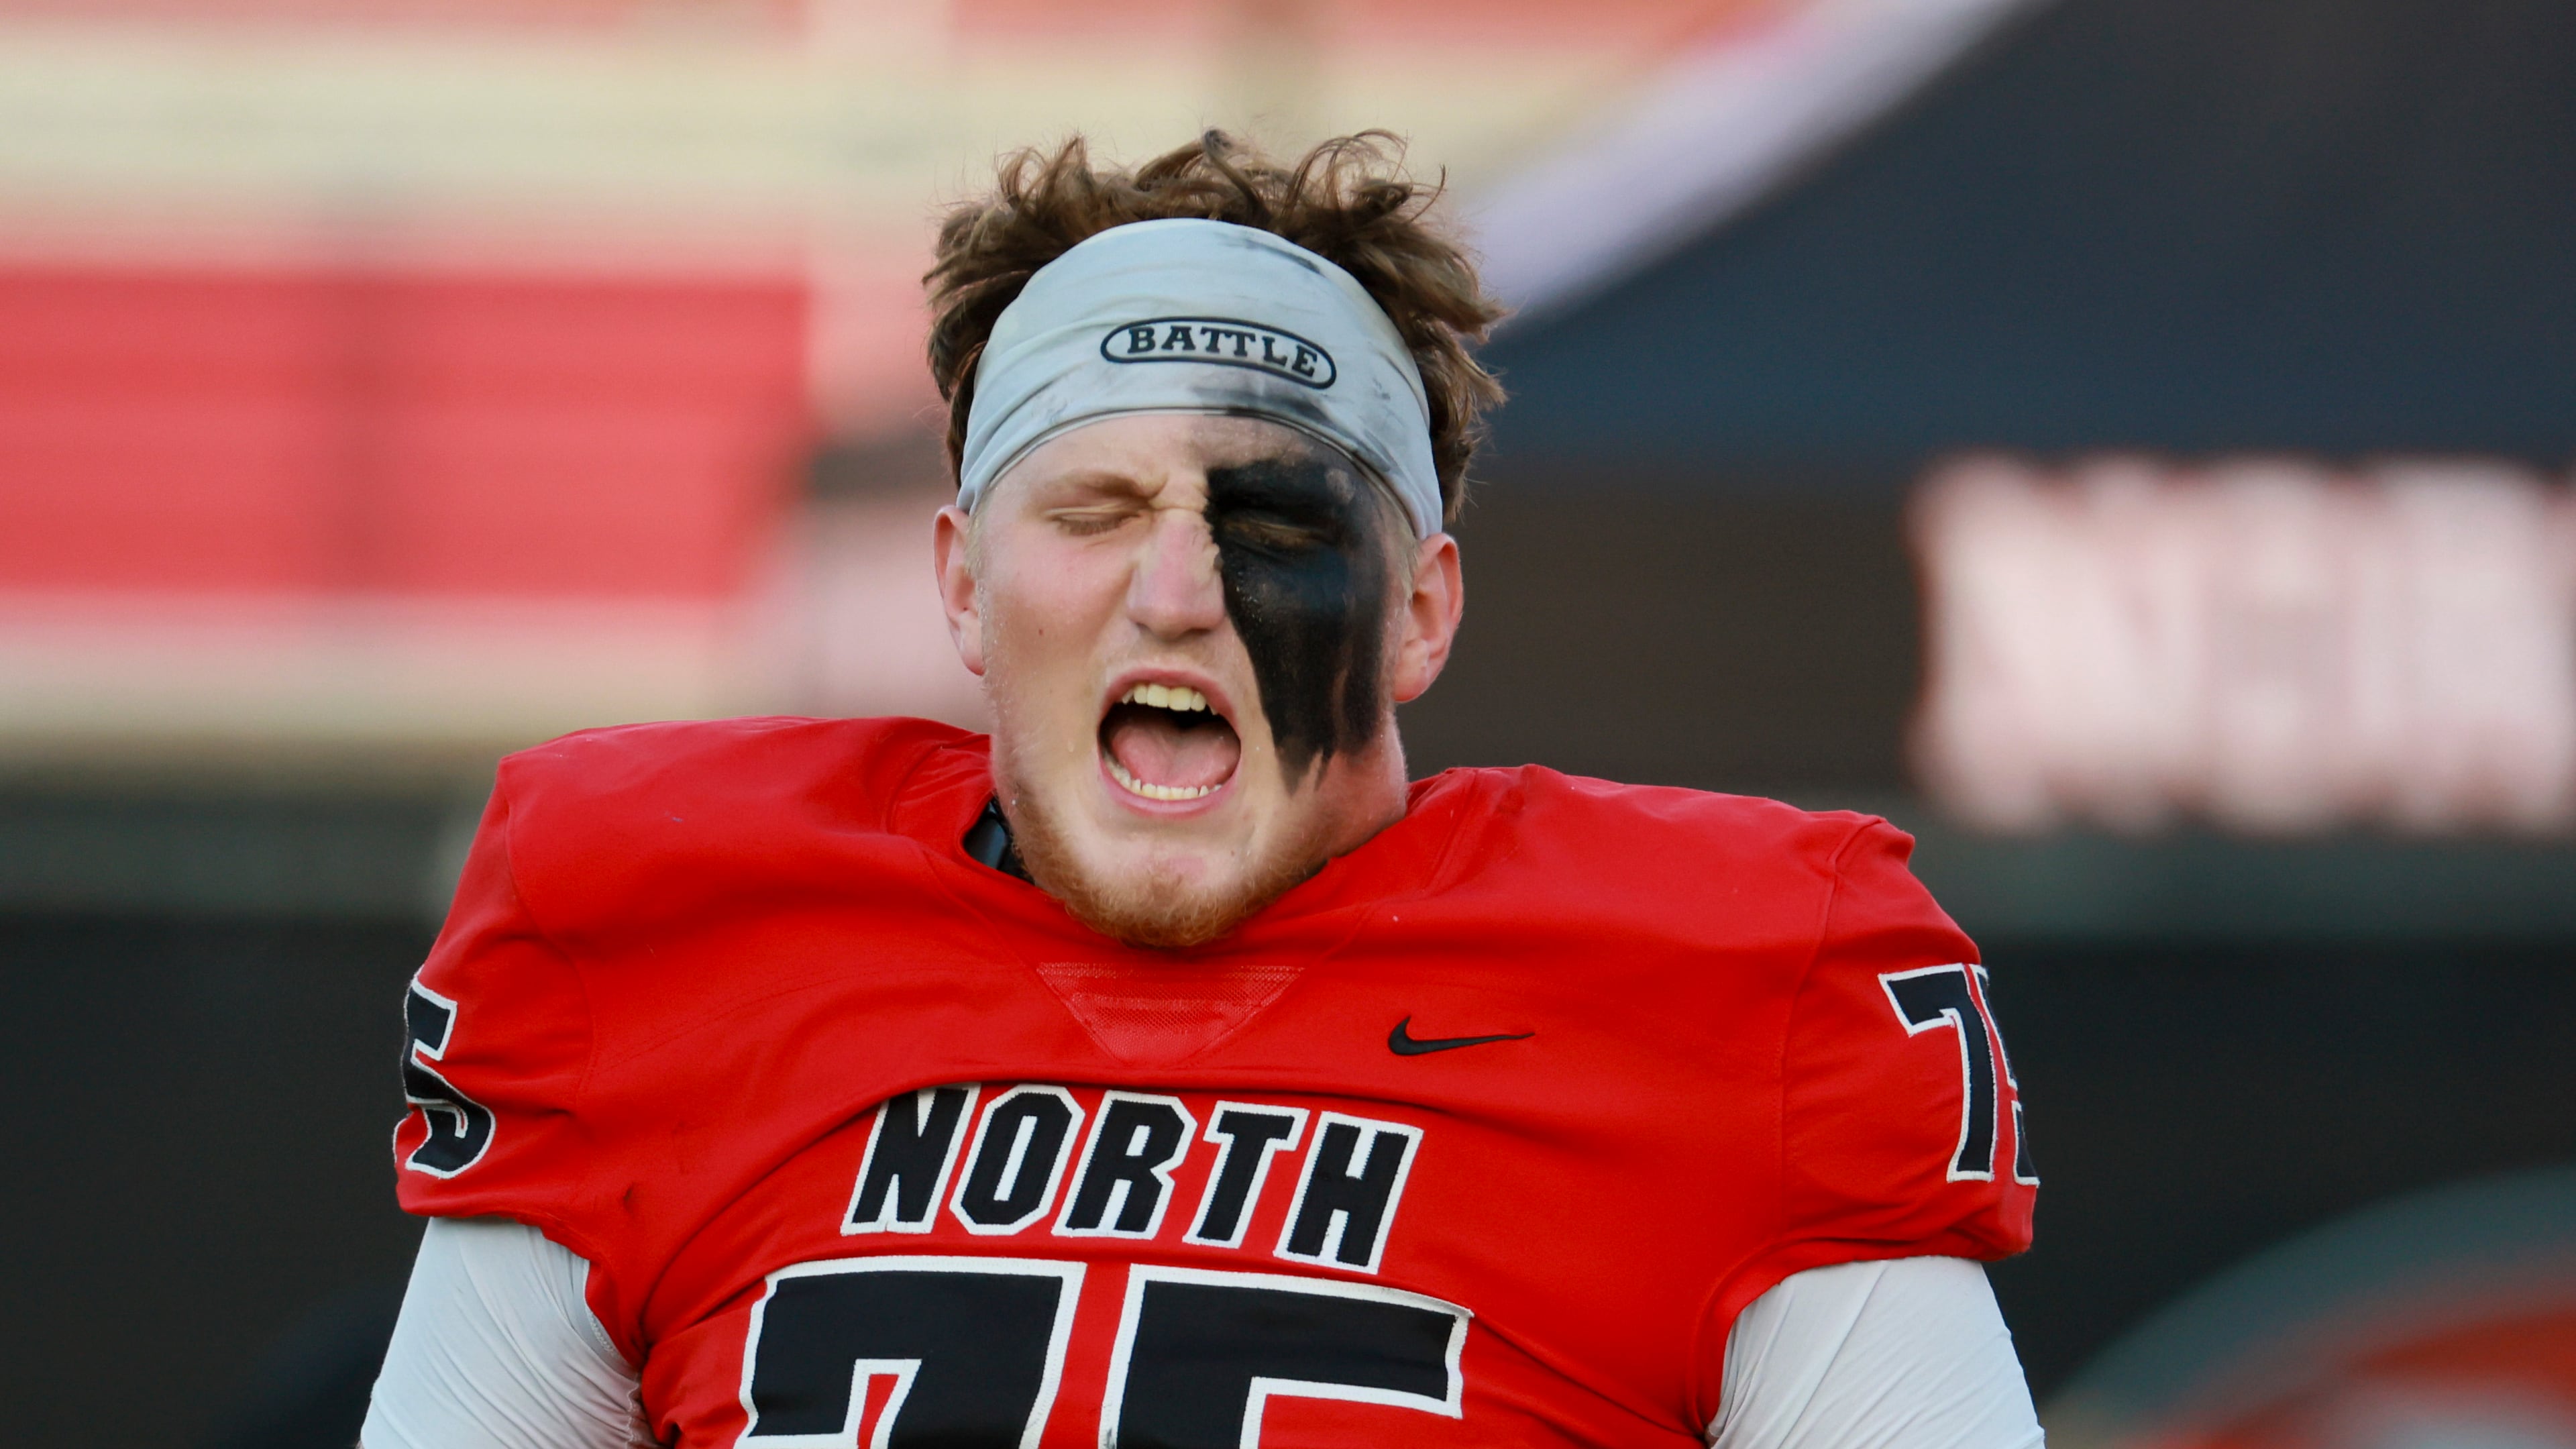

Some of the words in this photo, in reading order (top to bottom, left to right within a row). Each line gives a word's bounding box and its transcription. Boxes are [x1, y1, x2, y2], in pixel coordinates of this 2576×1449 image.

[1127, 325, 1319, 378] BATTLE
[1877, 962, 2041, 1187] 7
[840, 1082, 1424, 1275] NORTH
